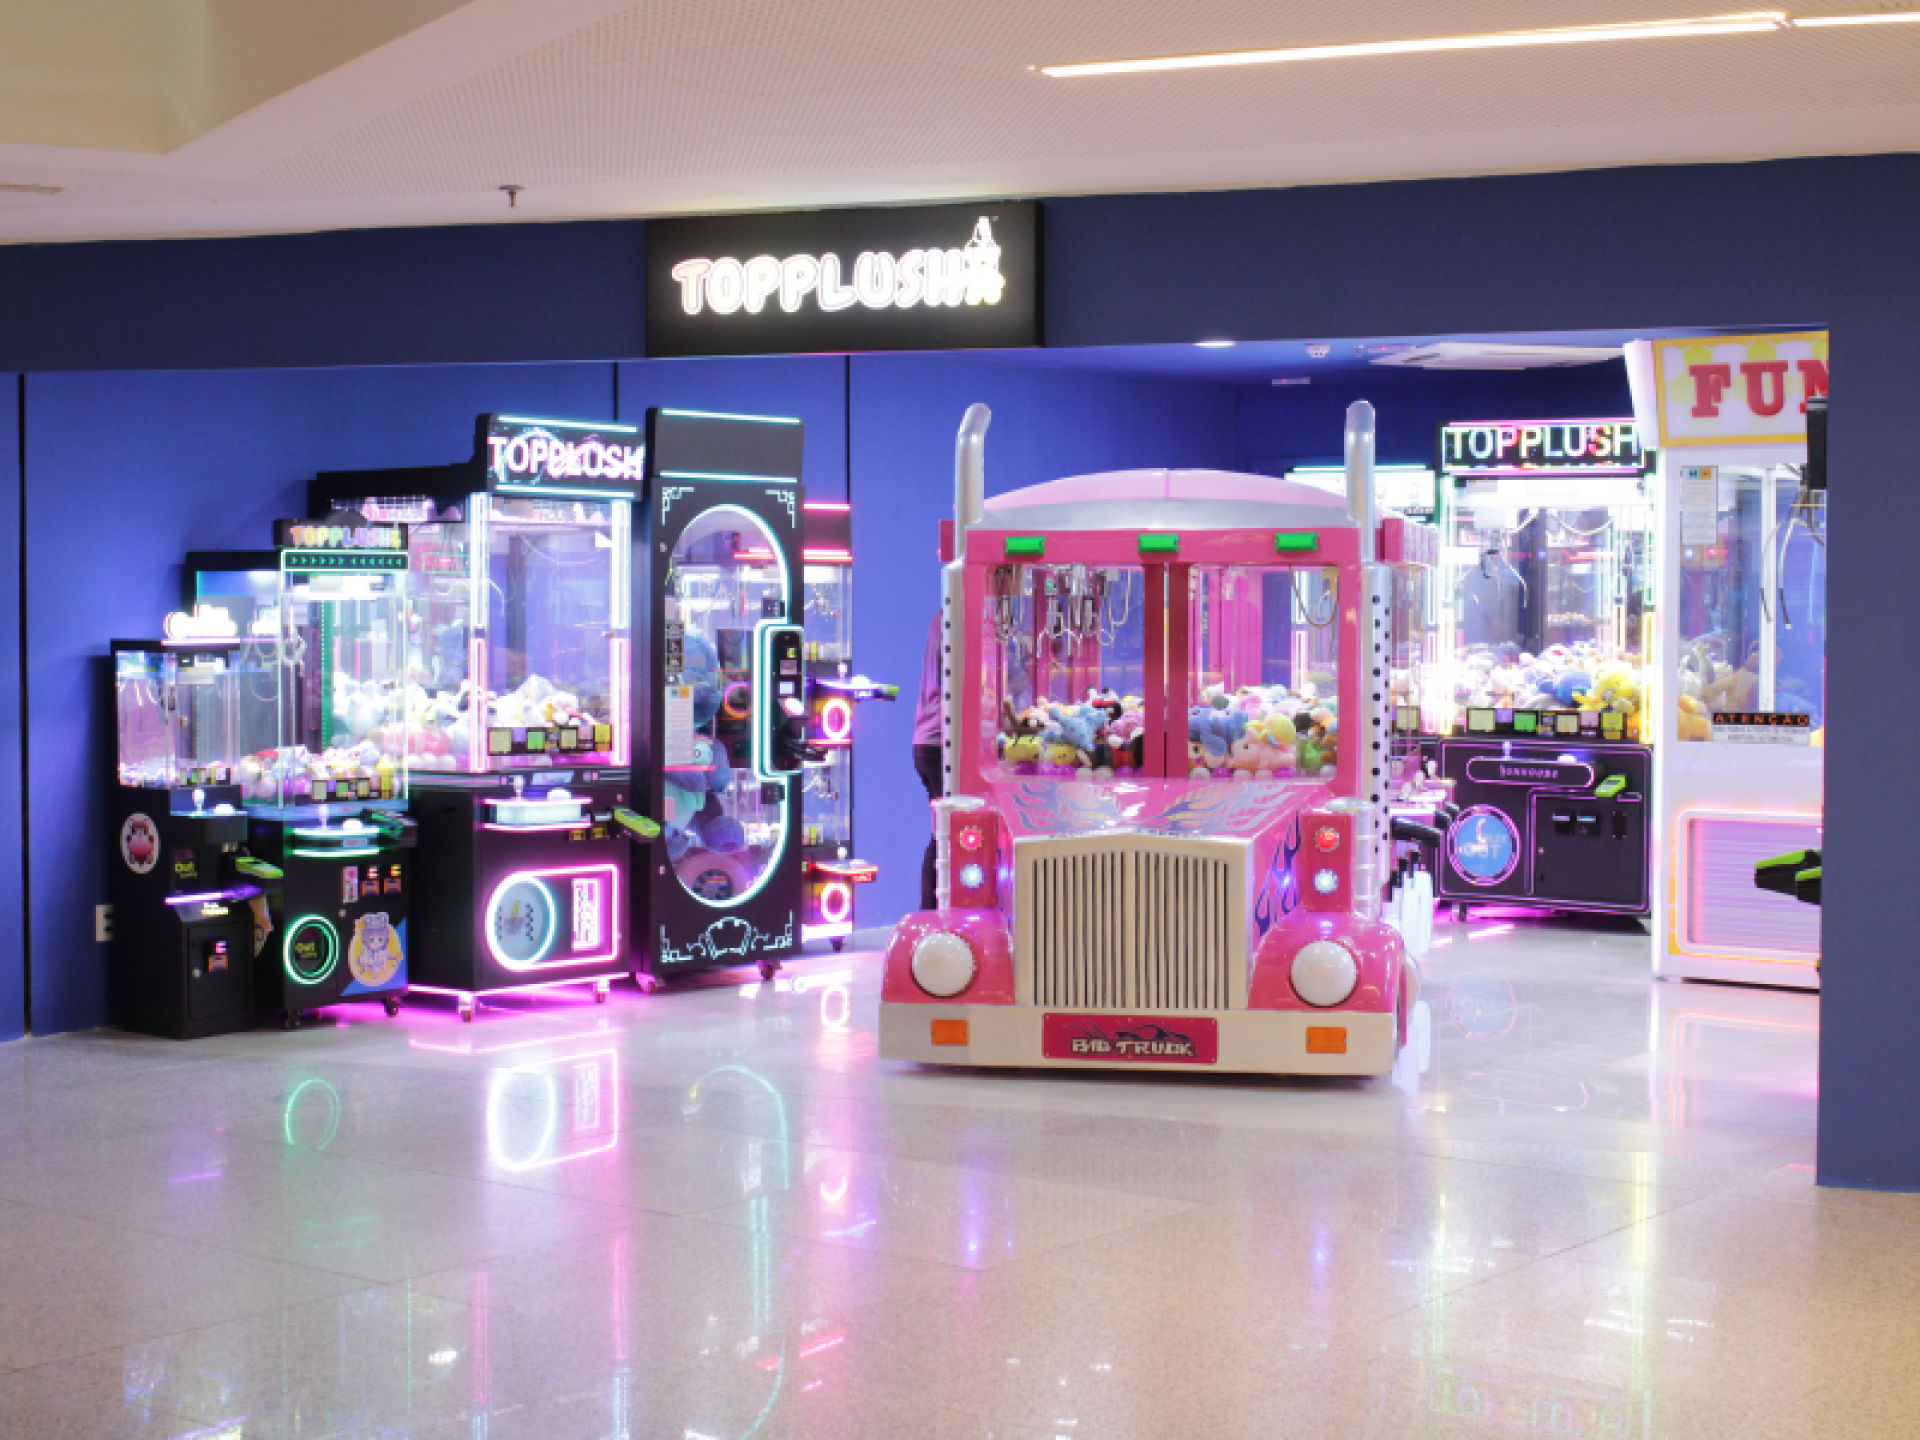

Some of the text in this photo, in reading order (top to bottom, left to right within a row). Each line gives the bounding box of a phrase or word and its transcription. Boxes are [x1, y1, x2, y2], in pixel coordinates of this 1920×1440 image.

[672, 247, 967, 315] TOPPLUSH
[1446, 425, 1639, 459] TOPPLUSH
[1115, 1040, 1196, 1057] TRUCK
